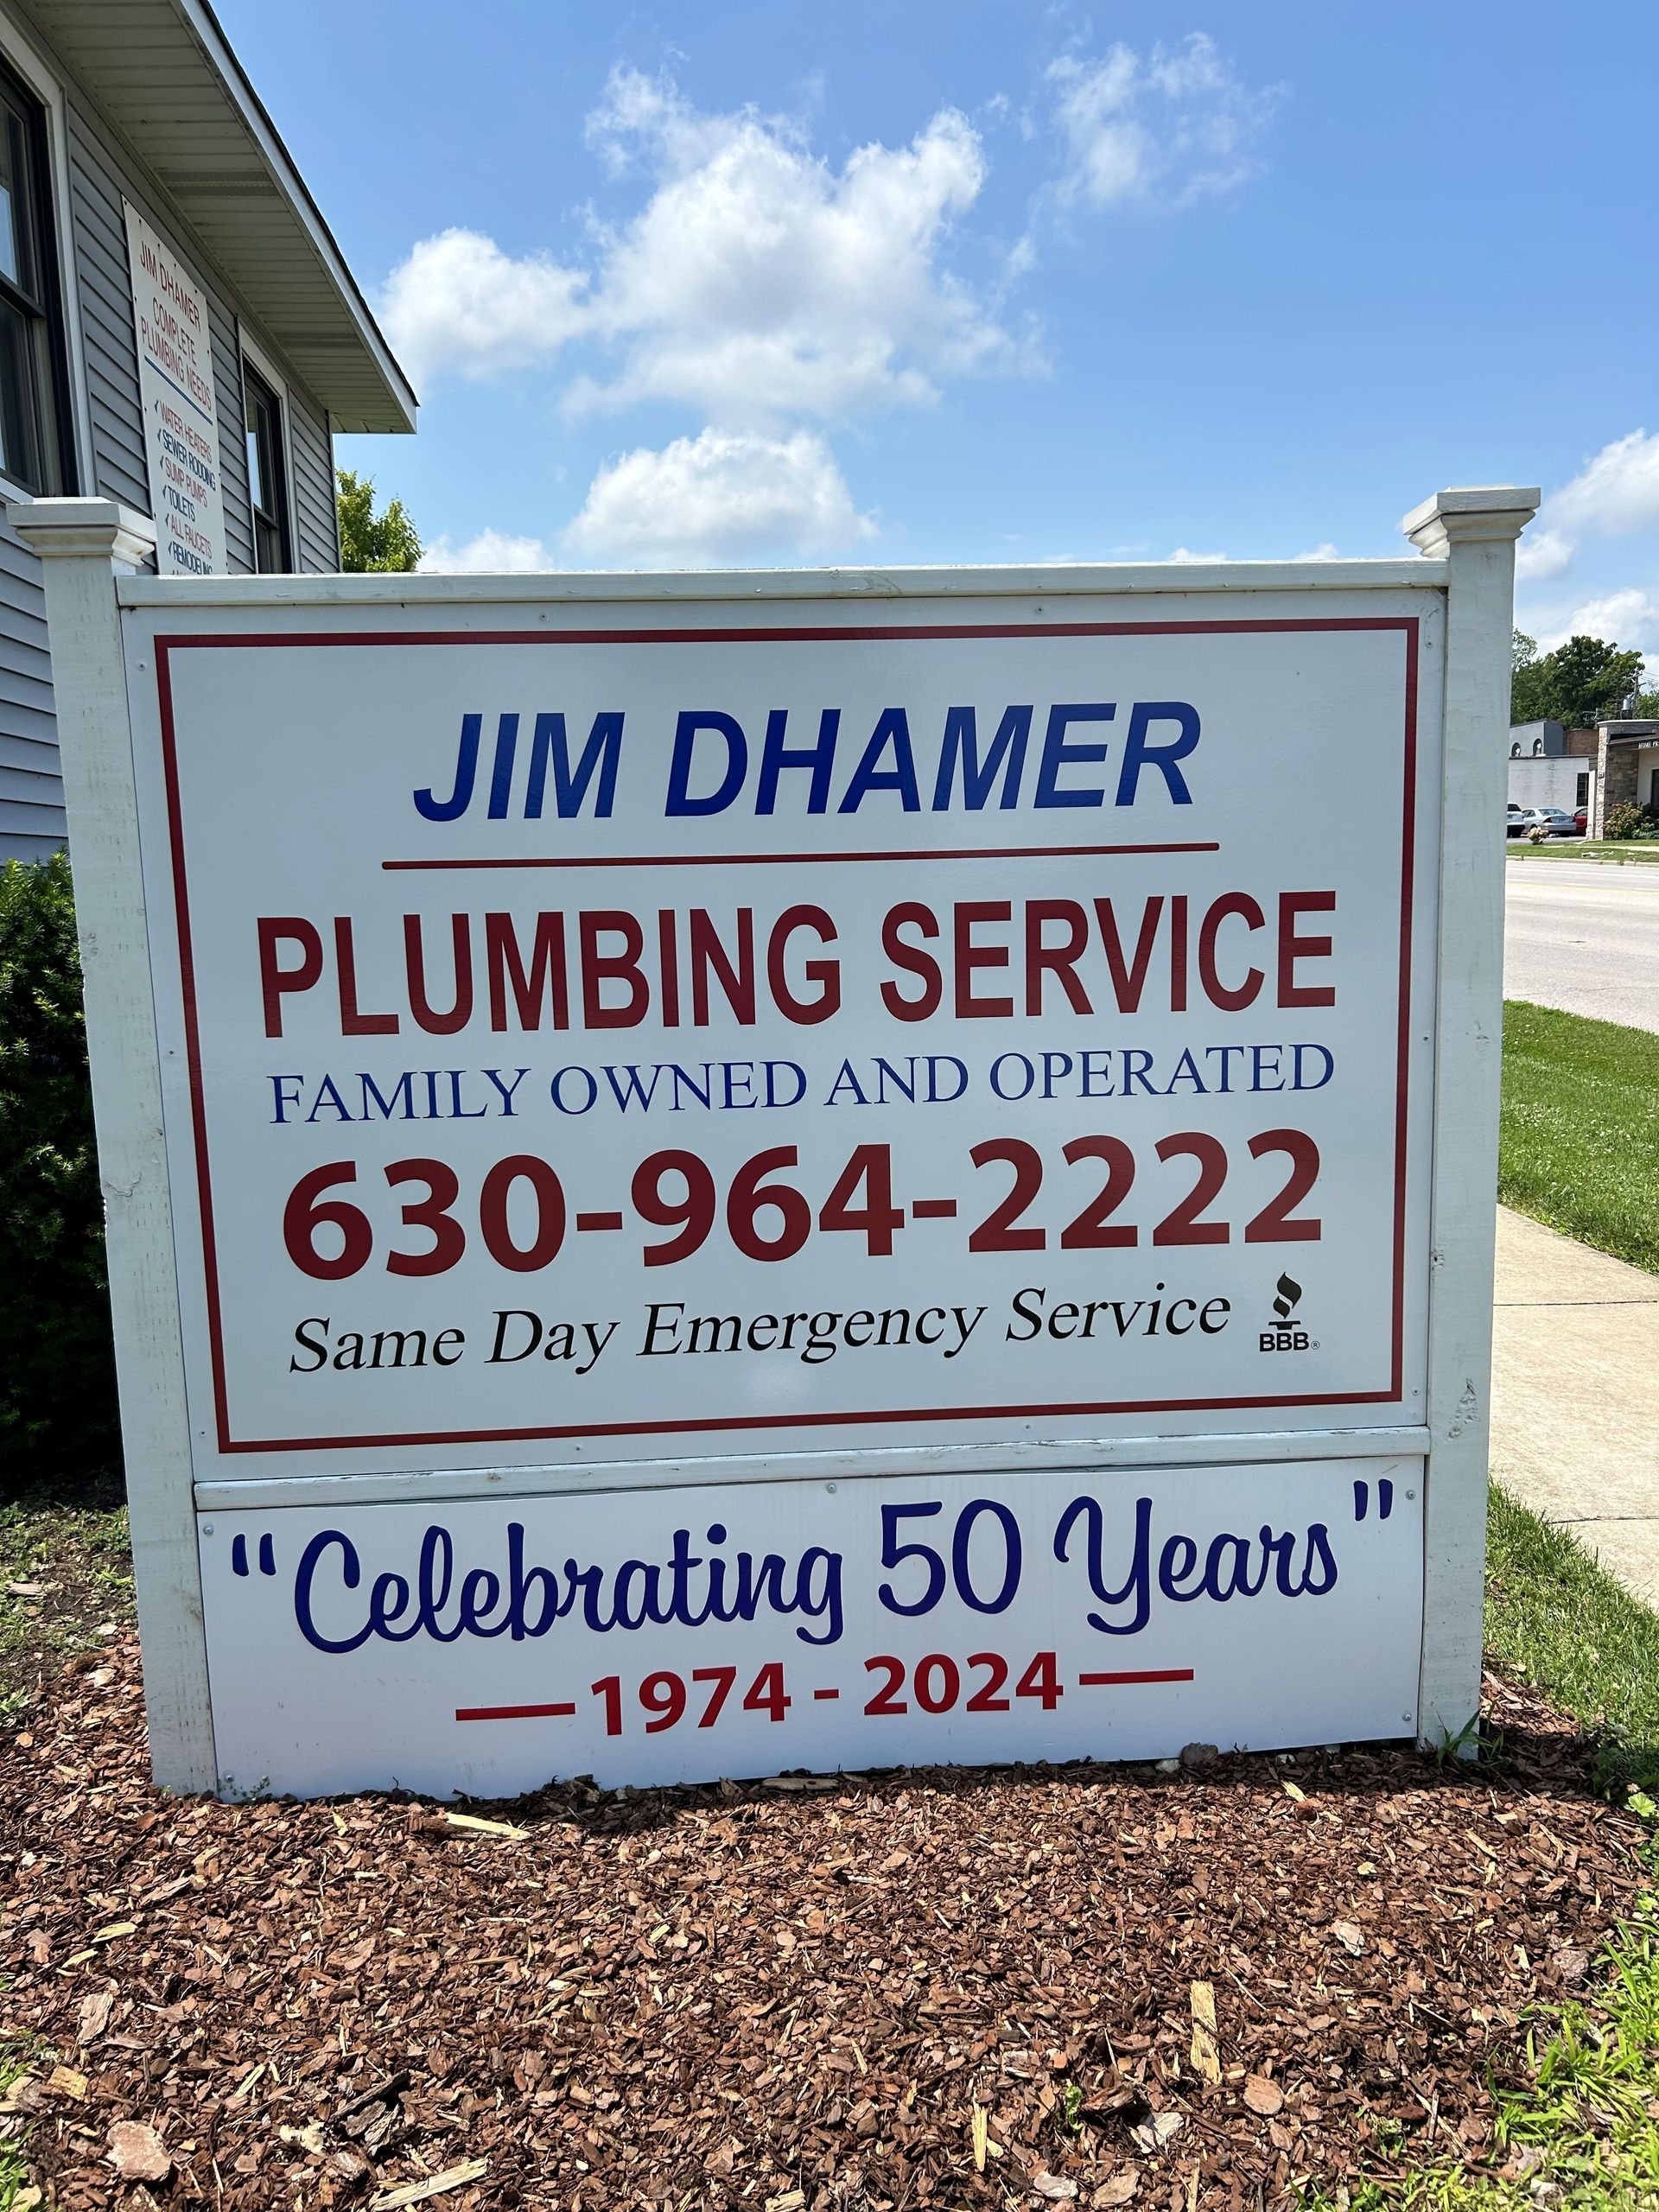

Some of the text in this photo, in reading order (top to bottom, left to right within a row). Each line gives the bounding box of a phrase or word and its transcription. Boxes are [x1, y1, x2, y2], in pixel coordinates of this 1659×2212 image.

[140, 240, 201, 333] JIM DHAMER
[141, 315, 212, 411] PLUMBING NEEDS
[152, 296, 197, 367] COMPLETE
[159, 399, 213, 464] WATER HEATERS
[162, 429, 216, 492] SEWER RODDING
[165, 456, 208, 508] SUMP PUMPS
[168, 485, 195, 523] TOILETS
[170, 514, 213, 560] ALL FAUCETS
[412, 701, 1201, 823] JIM DHAMER
[257, 890, 1337, 1039] PLUMBING SERVICE
[265, 1044, 1334, 1124] FAMILY OWNED AND OPERATED
[283, 1128, 1322, 1281] 630-964-2222
[289, 1281, 1231, 1376] Same Day Emergency Service
[878, 1498, 1022, 1618] 50
[590, 1662, 792, 1737] 1974
[863, 1651, 1065, 1716] 2024
